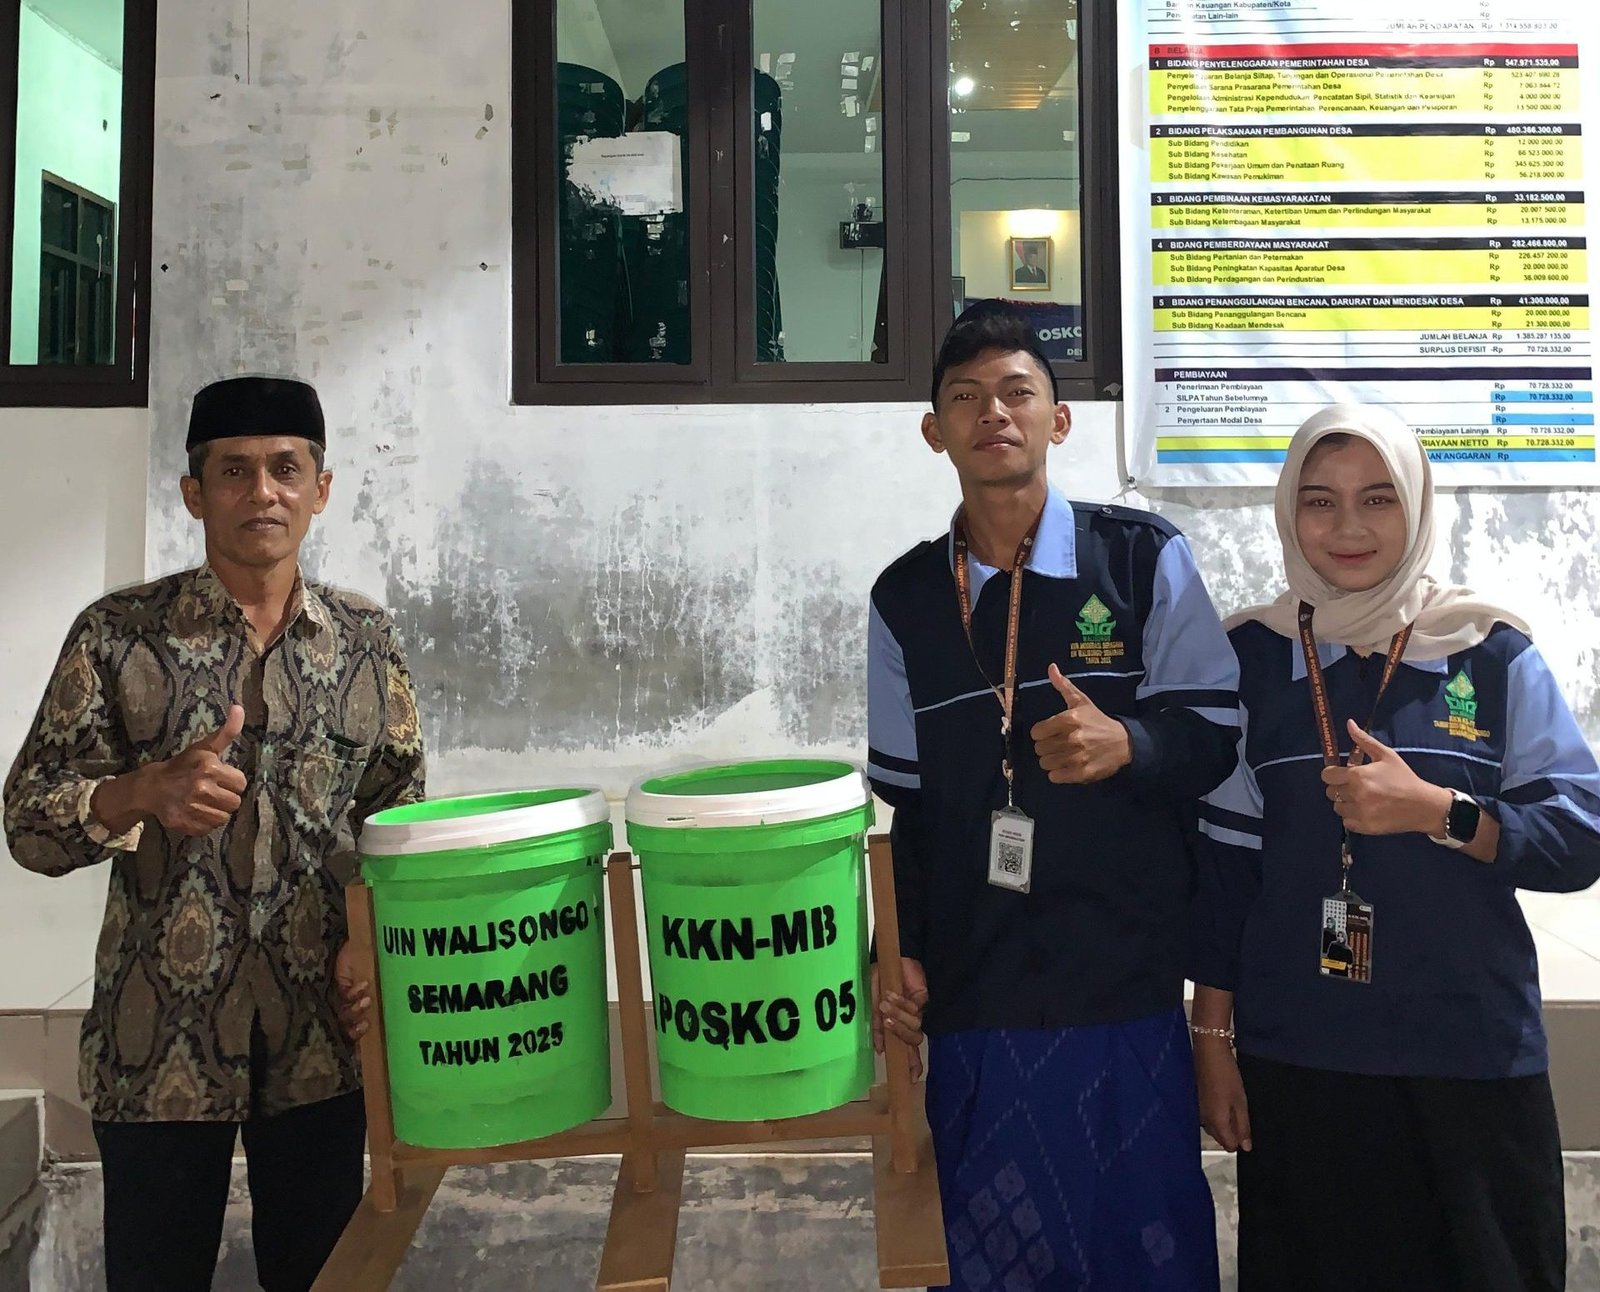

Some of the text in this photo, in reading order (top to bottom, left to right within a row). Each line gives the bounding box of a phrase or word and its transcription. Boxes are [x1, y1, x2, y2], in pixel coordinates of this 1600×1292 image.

[1167, 60, 1199, 68] BIDANG
[1199, 60, 1279, 68] PENYELENGGARAN
[1279, 59, 1345, 67] PEMERINTAHAN
[1484, 59, 1495, 67] Rp
[1370, 104, 1405, 112] Keuangan
[1329, 127, 1353, 135] DESA
[1485, 127, 1496, 135] Rp
[1184, 140, 1209, 148] Bidang
[1184, 151, 1209, 159] Bidang
[1184, 162, 1210, 170] Bidang
[1321, 162, 1344, 170] Ruang
[1184, 173, 1210, 181] Bidang
[1169, 195, 1202, 203] BIDANG
[1203, 195, 1250, 203] PEMBINAAN
[1251, 195, 1331, 203] KEMASYARAKATAN
[1485, 194, 1497, 203] Rp
[1185, 208, 1210, 216] Bidang
[1343, 207, 1391, 215] Perlindungan
[1393, 207, 1431, 215] Masyarakat
[1186, 219, 1211, 227] Bidang
[1212, 219, 1259, 227] Kelembagaan
[1261, 219, 1301, 227] Masyarakat
[1170, 241, 1202, 249] BIDANG
[1204, 241, 1271, 249] PEMBERDAYAAN
[1272, 241, 1329, 249] MASYARAKAT
[1489, 240, 1501, 248] Rp
[1186, 254, 1212, 262] Bidang
[1489, 252, 1500, 260] Rp
[1186, 265, 1212, 273] Bidang
[1213, 265, 1257, 273] Peningkatan
[1259, 265, 1293, 273] Kapasitas
[1295, 265, 1324, 273] Aparatur
[1490, 263, 1500, 271] Rp
[1186, 276, 1212, 284] Bidang
[1213, 276, 1261, 284] Perdagangan
[1490, 274, 1500, 282] Rp
[1172, 298, 1204, 306] BIDANG
[1205, 298, 1285, 306] PENANGGULANGAN
[1287, 298, 1329, 307] BENCANA,
[1330, 298, 1372, 306] DARURAT
[1373, 298, 1390, 306] DAN
[1392, 298, 1439, 306] MENDESAK
[1490, 297, 1502, 306] Rp
[1188, 311, 1213, 319] Bidang
[1214, 311, 1274, 319] Penanggulangan
[1491, 309, 1501, 317] Rp
[1188, 322, 1213, 330] Bidang
[1036, 326, 1082, 341] OSKO
[1492, 333, 1502, 341] Rp
[1221, 384, 1263, 392] Pembiayaan
[1495, 394, 1506, 402] Rp
[1177, 406, 1223, 414] Pengeluaran
[1225, 406, 1267, 414] Pembiayaan
[1496, 405, 1506, 413] Rp
[1177, 417, 1219, 426] Penyertaan
[1496, 416, 1507, 424] Rp
[1497, 427, 1507, 435] Rp
[1497, 439, 1508, 447] Rp
[1497, 453, 1509, 461] Rp
[1310, 658, 1319, 684] POSKO
[1317, 696, 1326, 718] DESA
[383, 901, 589, 957] UIN WALISONGO
[662, 905, 837, 961] KKN-MB
[408, 964, 569, 1014] SEMARANG
[815, 980, 856, 1032] 05
[419, 1022, 564, 1066] TAHUN 2025
